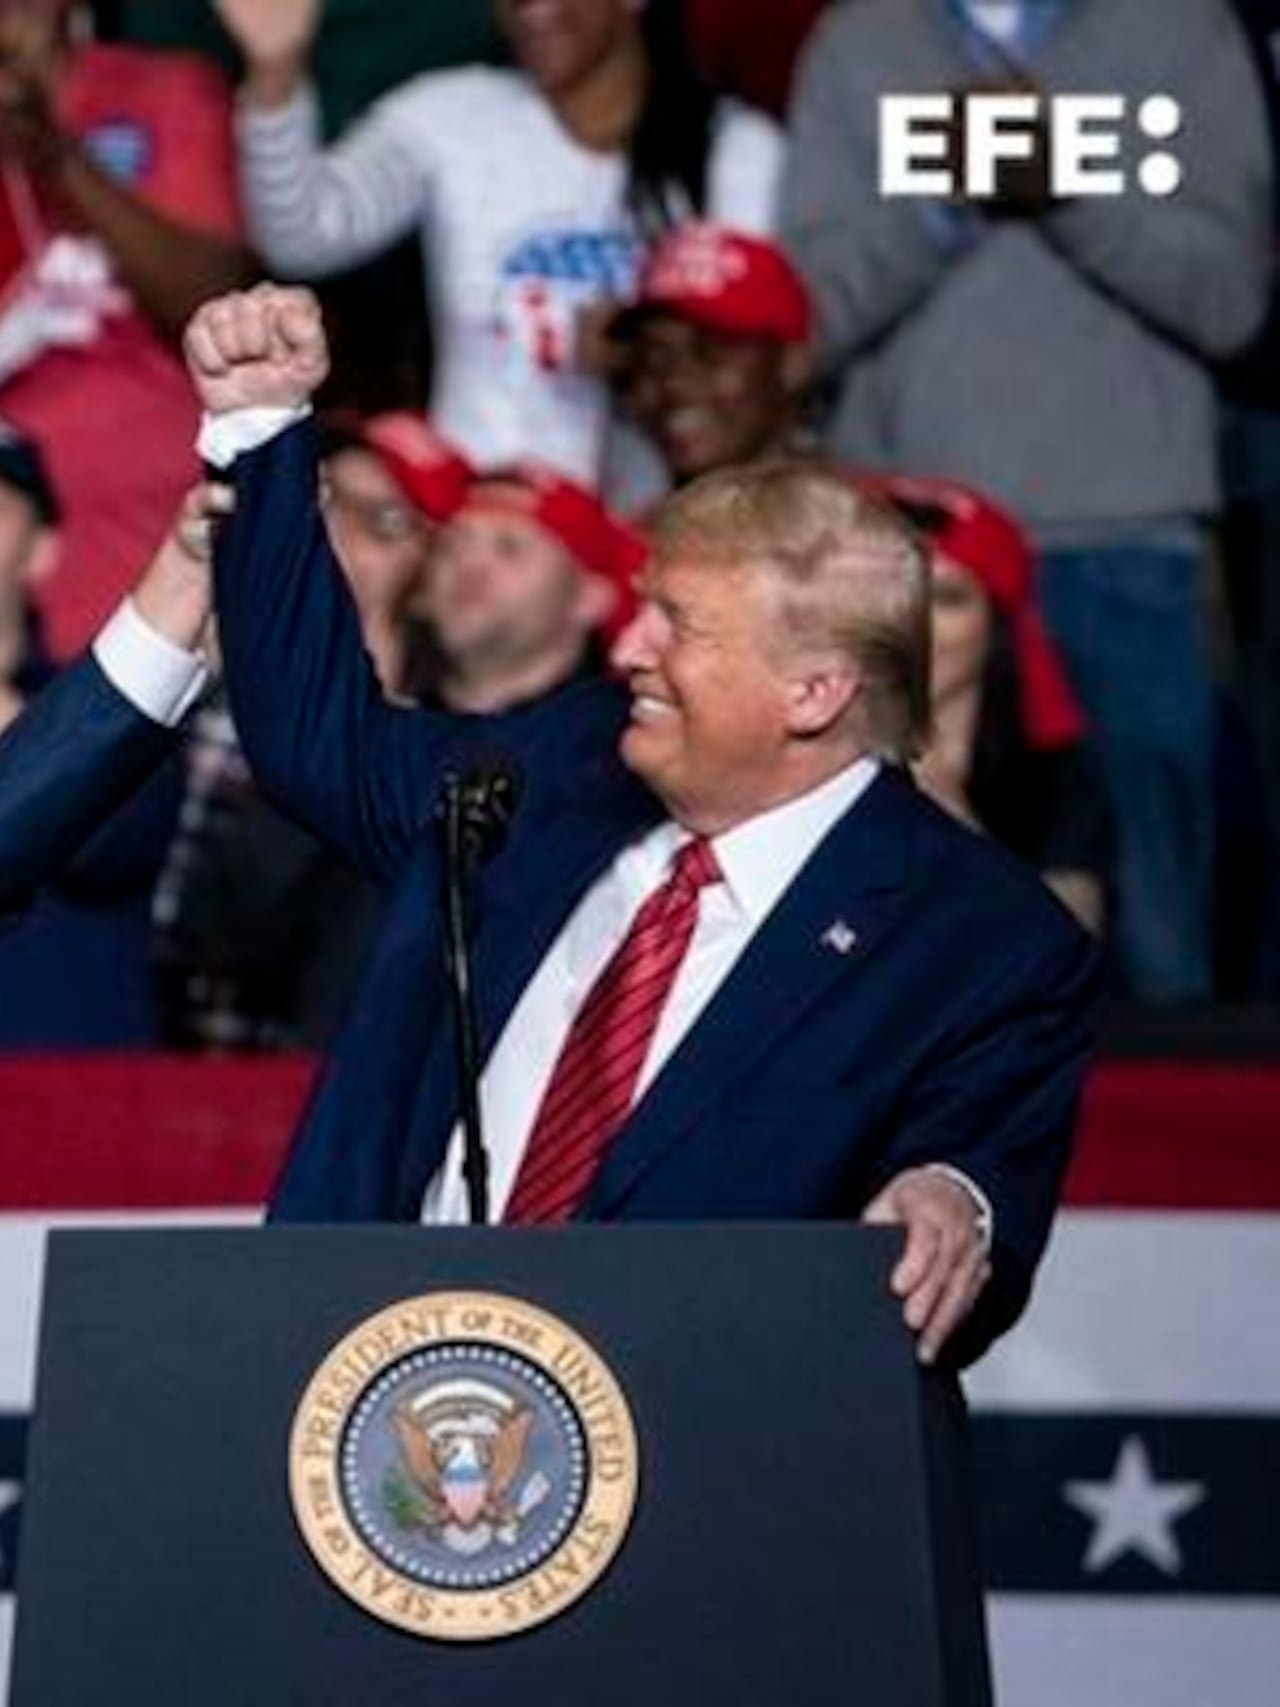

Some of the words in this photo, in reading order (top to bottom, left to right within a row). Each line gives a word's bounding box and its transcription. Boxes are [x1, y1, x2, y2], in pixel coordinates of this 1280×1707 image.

[460, 1309, 492, 1332] OF
[303, 1309, 448, 1457] PRESIDENT
[552, 1346, 625, 1482] UNITED
[496, 1513, 612, 1620] STATES
